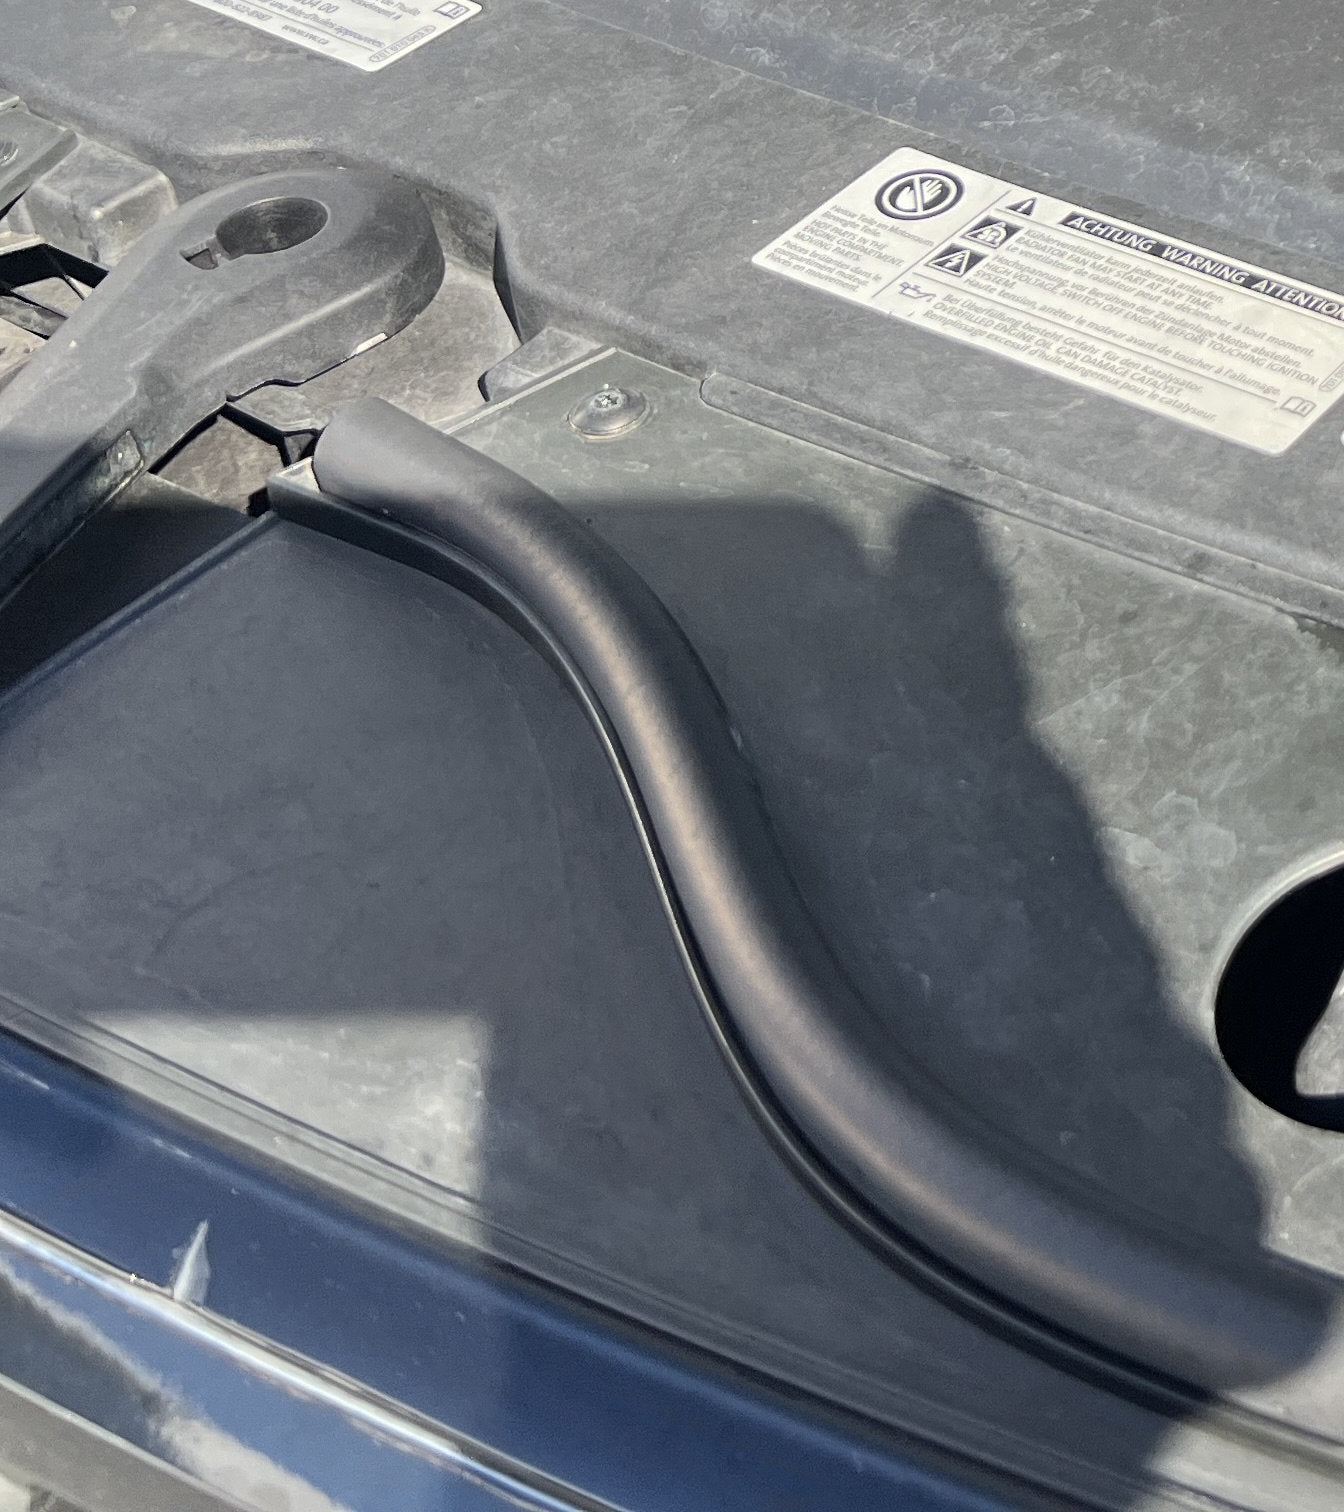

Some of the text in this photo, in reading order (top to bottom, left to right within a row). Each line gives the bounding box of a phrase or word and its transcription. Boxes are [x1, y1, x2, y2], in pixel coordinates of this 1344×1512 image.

[315, 2, 340, 13] 00
[1015, 236, 1216, 309] RADIATOR FAN MAY START AT ANY TIME.
[1067, 215, 1157, 251] ACHTUNG
[1158, 246, 1251, 283] WARNING
[934, 301, 1185, 396] OVERFILLED ENGINE OIL CAN DAMAGE CATALYST.
[943, 294, 1208, 393] Bei Überfüllung besteht Gefahr für den Katalysator.
[983, 262, 1014, 275] HIGH
[1059, 289, 1104, 307] SWITCH
[1101, 303, 1125, 315] OFF
[1122, 311, 1167, 330] ENGINE
[1164, 326, 1207, 344] BEFORE
[1206, 341, 1267, 365] TOUCHING
[1265, 362, 1319, 384] IGNITION
